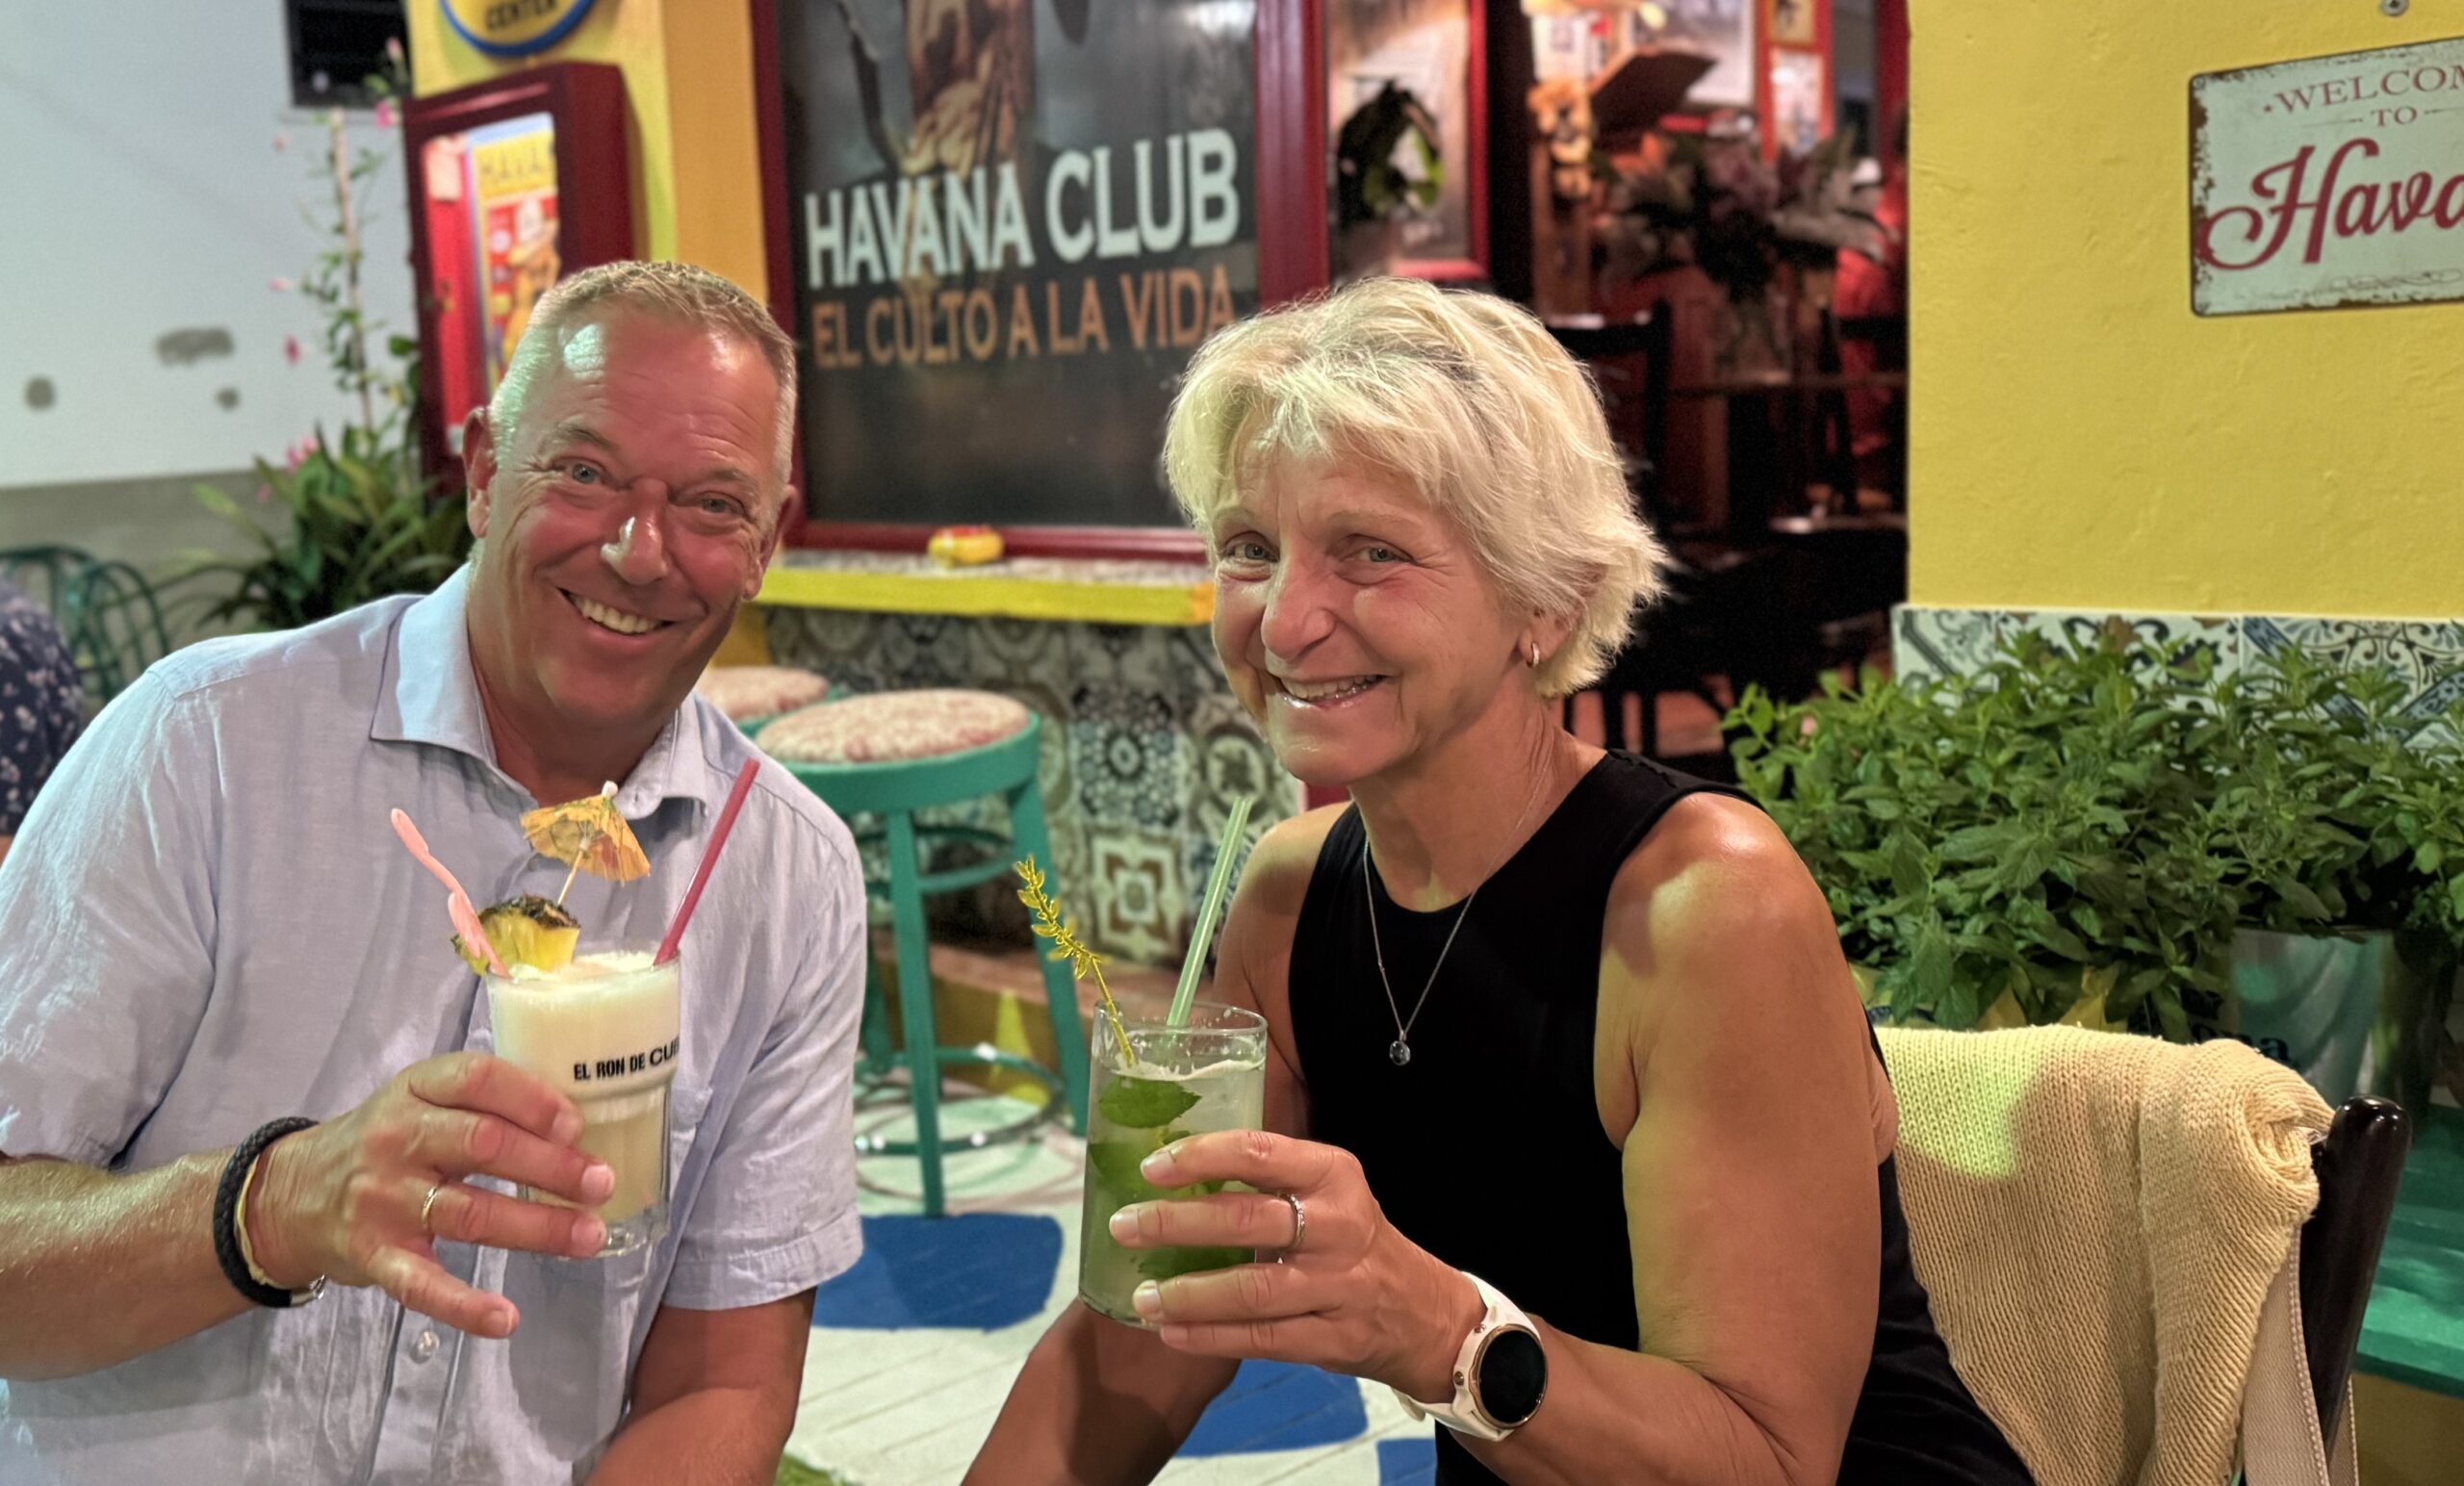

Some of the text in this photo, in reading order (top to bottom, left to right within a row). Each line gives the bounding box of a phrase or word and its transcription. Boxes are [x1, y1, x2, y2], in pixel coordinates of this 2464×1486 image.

[2371, 106, 2418, 127] TO
[805, 128, 1240, 289] HAVANA CLUB
[811, 264, 1237, 369] EL CULTO A LA VIDA
[574, 1063, 591, 1081] EL
[596, 1057, 626, 1079] RON
[629, 1053, 646, 1073] DE
